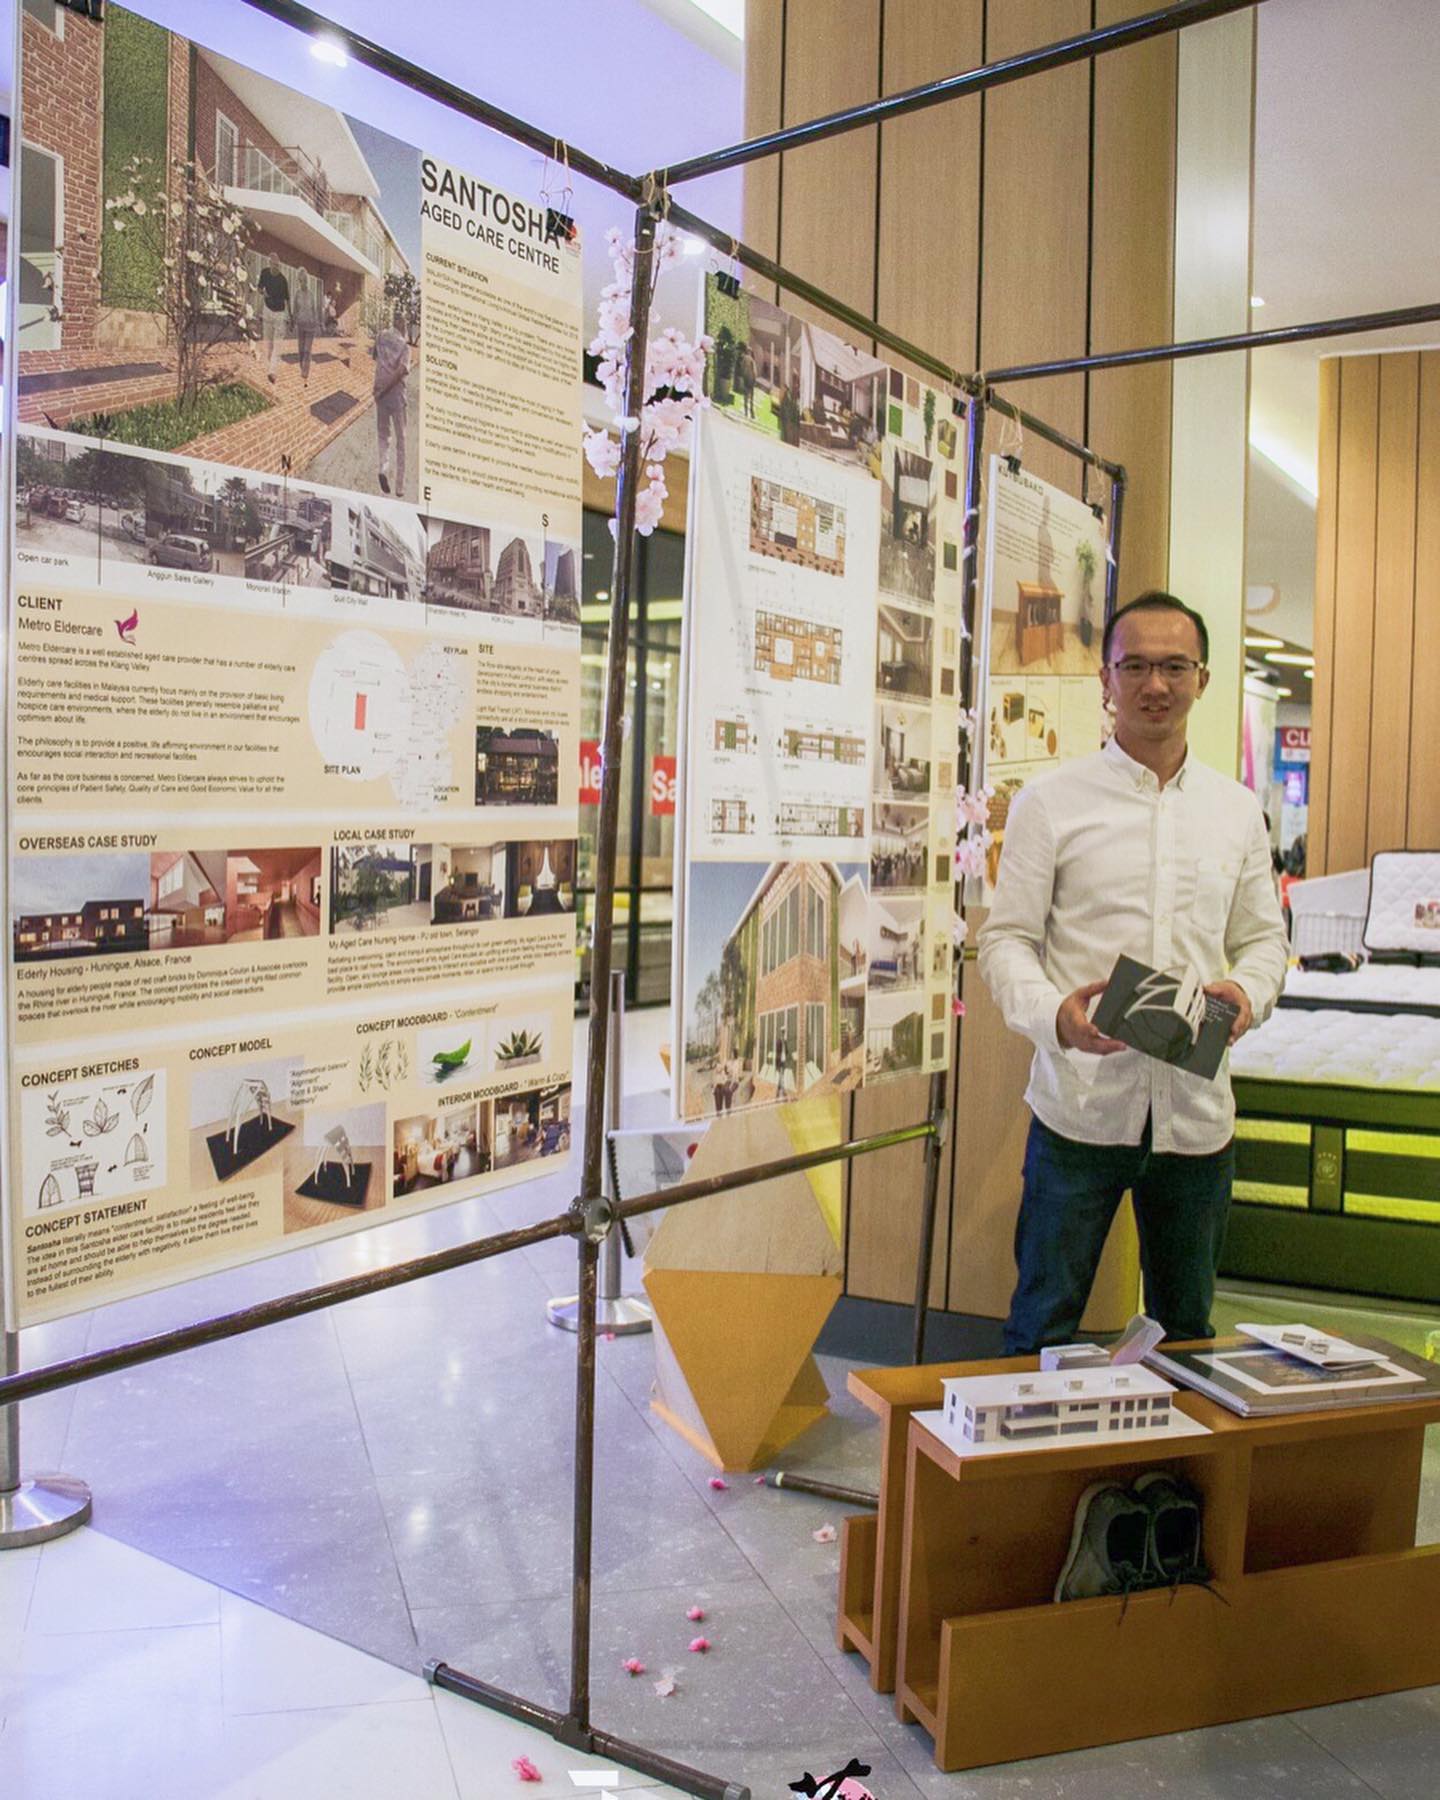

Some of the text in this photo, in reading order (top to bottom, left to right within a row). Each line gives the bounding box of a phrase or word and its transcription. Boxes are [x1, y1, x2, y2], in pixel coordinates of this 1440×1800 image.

[420, 200, 462, 230] AGED
[466, 220, 504, 250] CARE
[508, 238, 560, 274] CENTRE
[426, 252, 488, 284] CURRENT SITUATION
[426, 354, 458, 372] SOLUTION
[282, 454, 291, 470] N
[424, 487, 431, 501] E
[542, 513, 549, 527] S
[18, 552, 39, 566] Open
[53, 558, 69, 568] park
[18, 595, 62, 611] CLIENT
[18, 617, 103, 637] Metro Eldercare
[479, 643, 494, 655] SITE
[324, 764, 361, 775] SITE PLAN
[19, 835, 158, 850] OVERSEAS CASE STUDY
[334, 828, 415, 841] LOCAL CASE STUDY
[356, 1020, 395, 1034] CONCEPT
[397, 1011, 448, 1028] MOODBOARD
[189, 1038, 272, 1060] CONCEPT MODEL
[21, 1058, 139, 1087] CONCEPT SKETCHES
[438, 1091, 472, 1107] INTERIOR
[473, 1081, 518, 1100] MOODBOARD
[25, 1199, 147, 1238] CONCEPT STATEMENT
